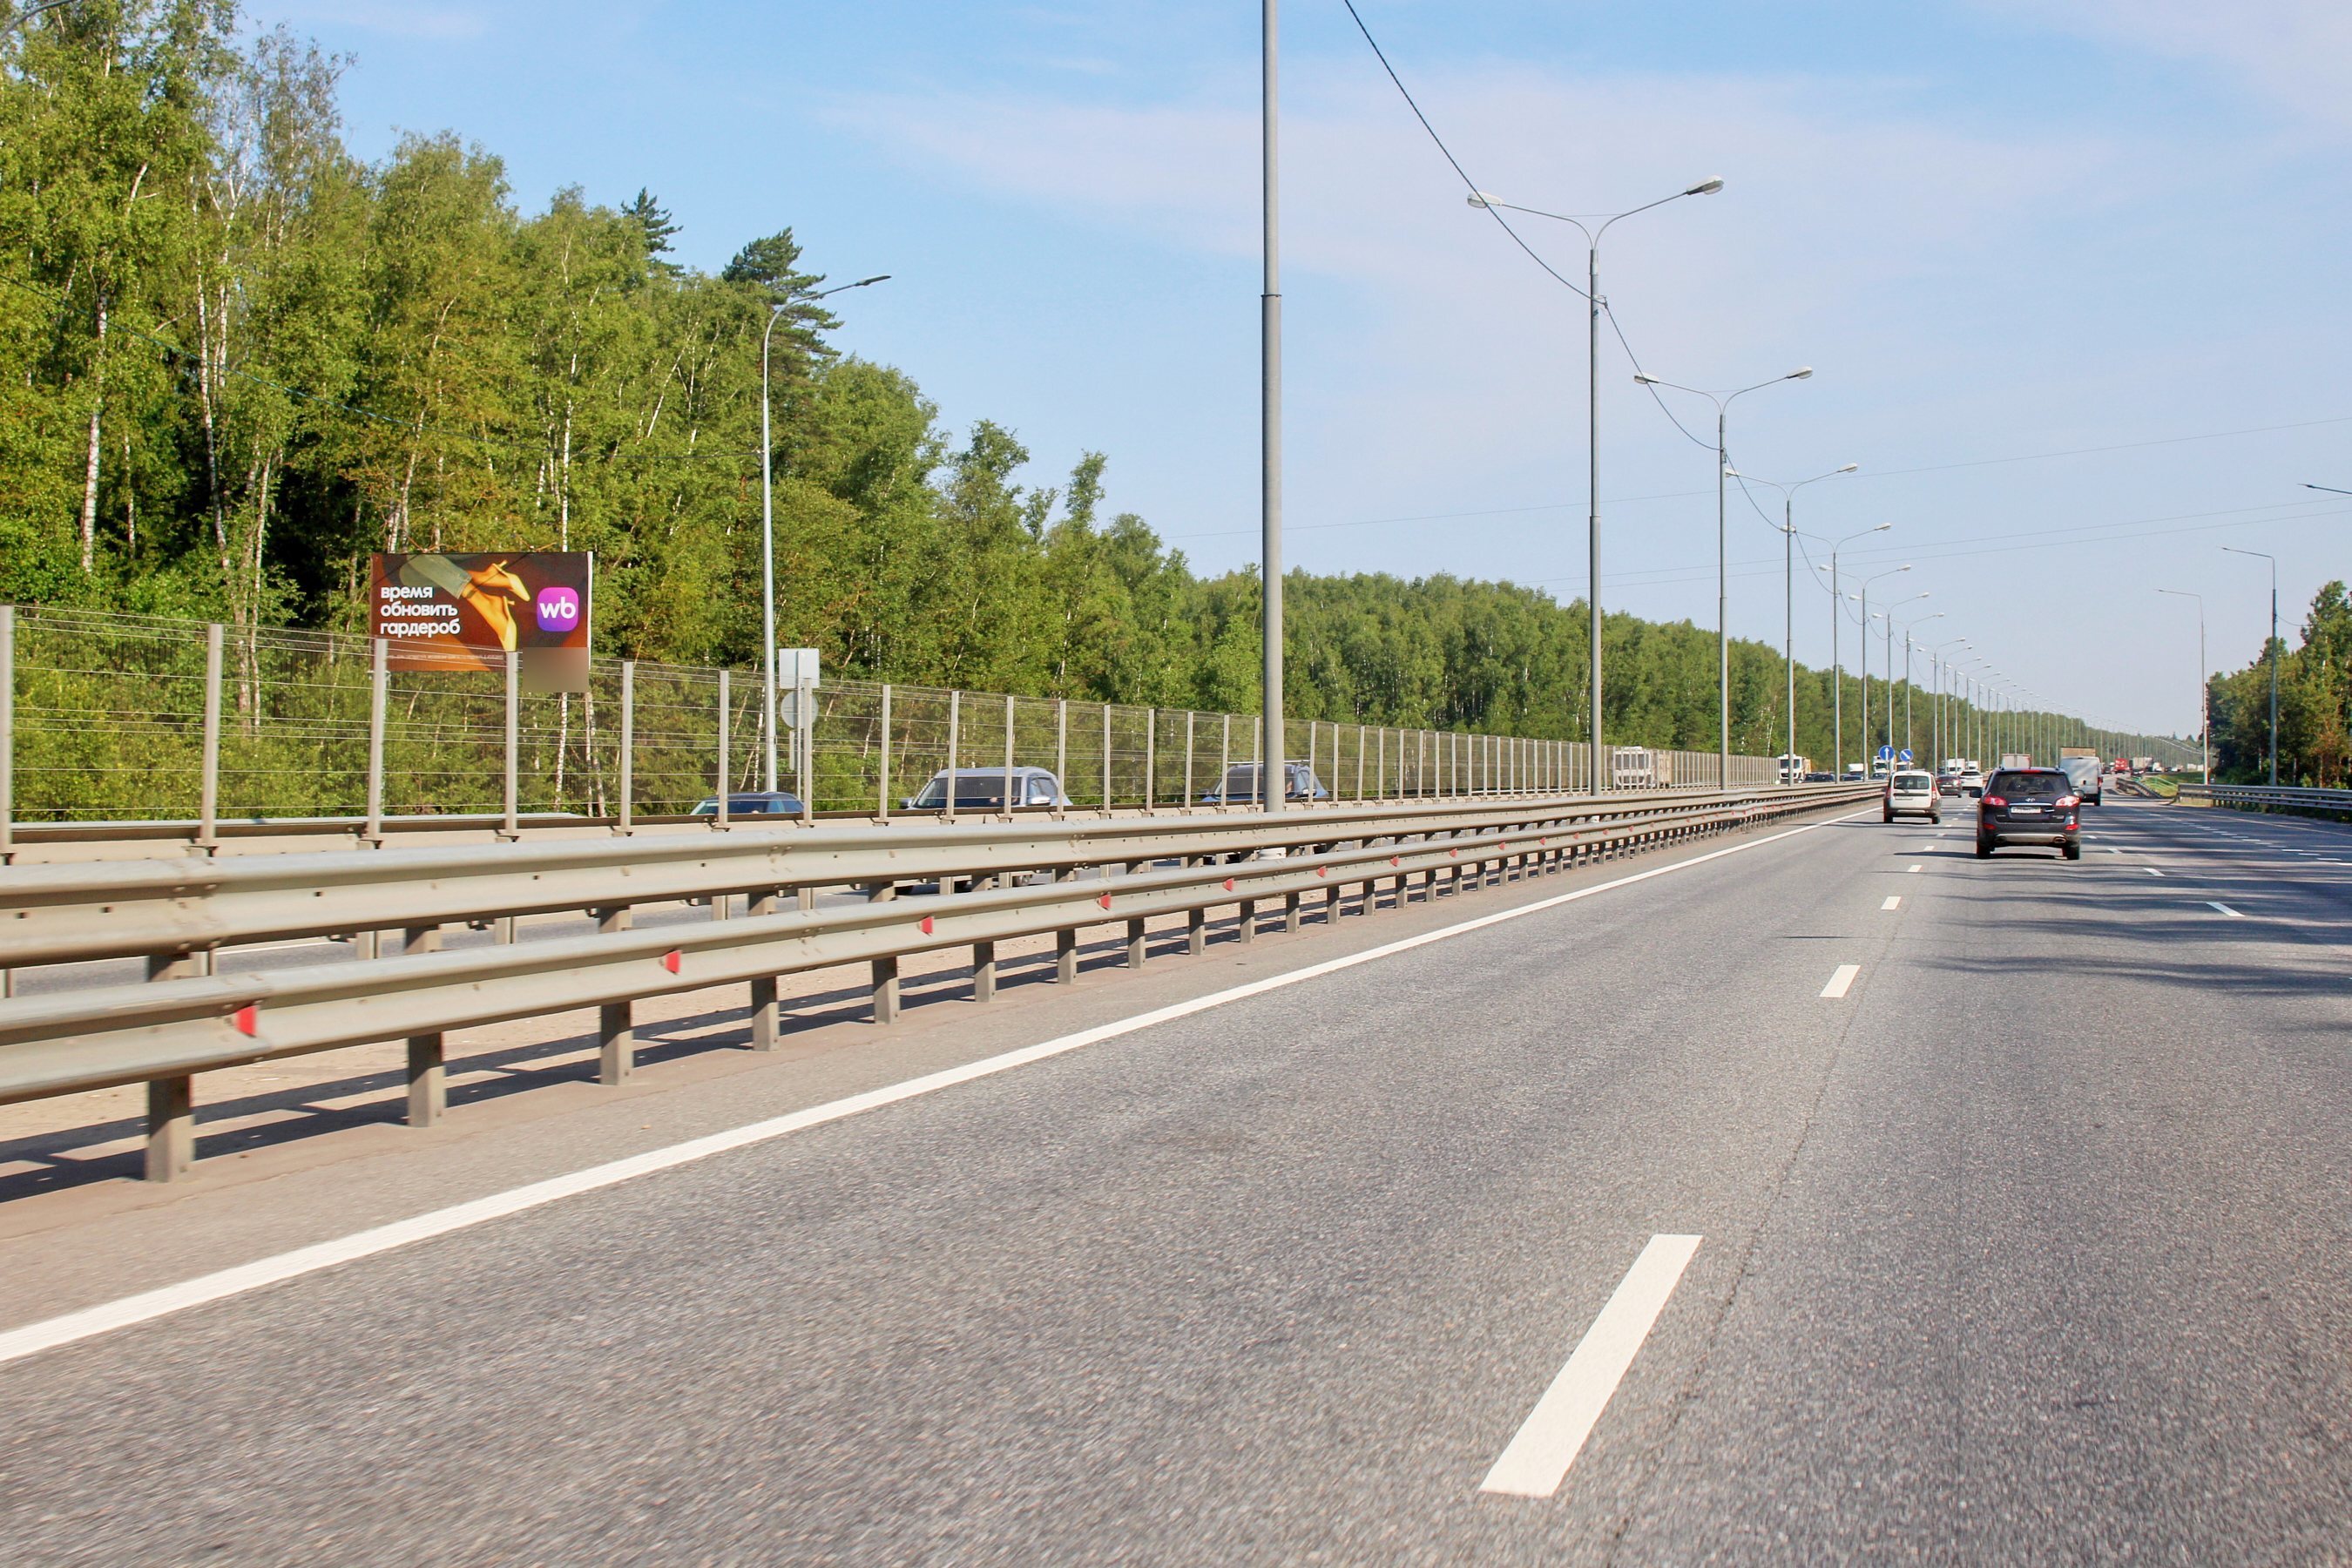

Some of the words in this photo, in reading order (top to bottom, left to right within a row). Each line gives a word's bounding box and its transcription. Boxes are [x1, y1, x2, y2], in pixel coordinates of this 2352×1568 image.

[381, 586, 433, 602] время
[380, 600, 458, 617] обновить
[539, 596, 576, 618] wb
[380, 618, 460, 638] гардероб
